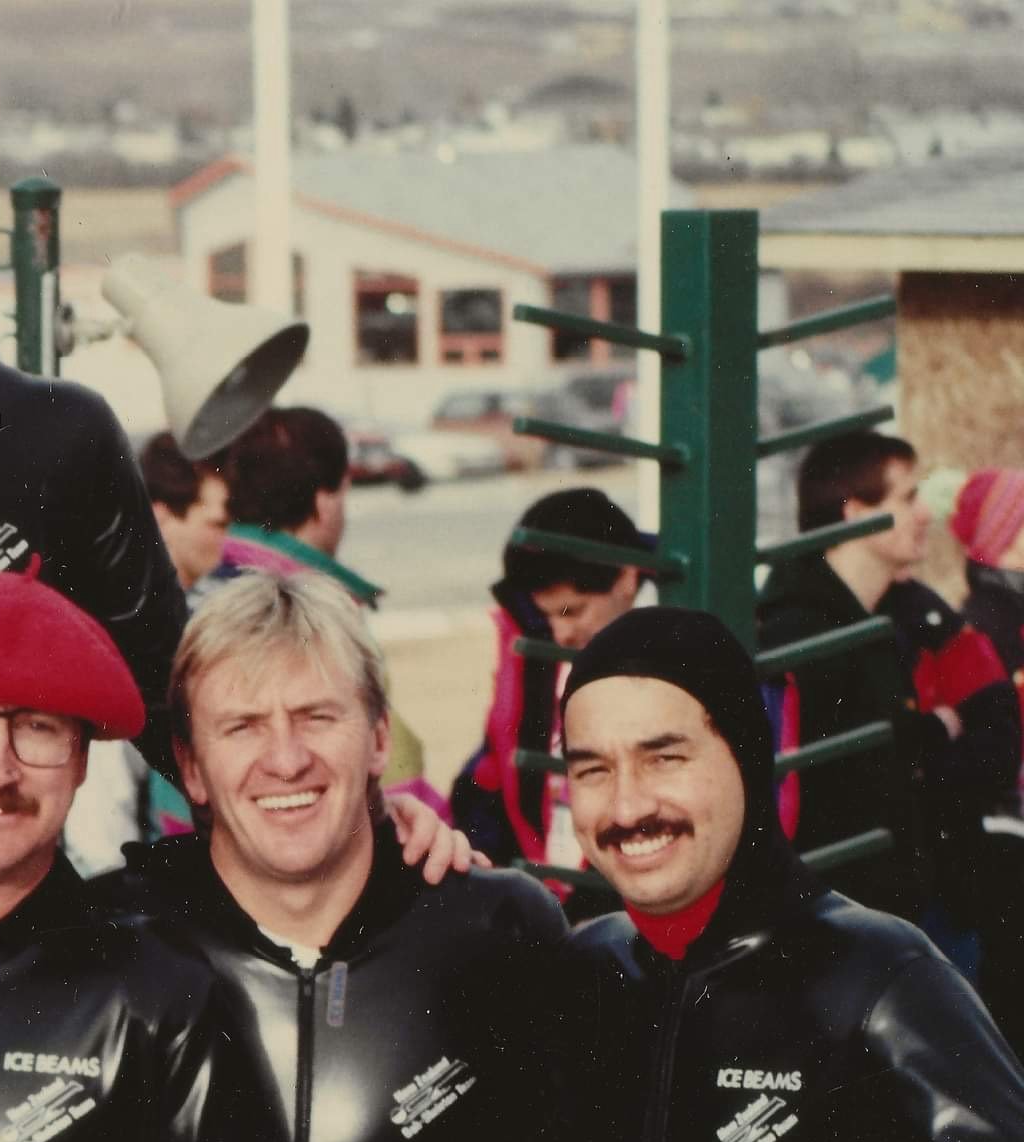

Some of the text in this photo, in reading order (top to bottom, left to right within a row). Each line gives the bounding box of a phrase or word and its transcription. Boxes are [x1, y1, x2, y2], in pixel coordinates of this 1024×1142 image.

[3, 1052, 100, 1077] ICE BEAMS
[717, 1068, 802, 1091] ICE BEAMS
